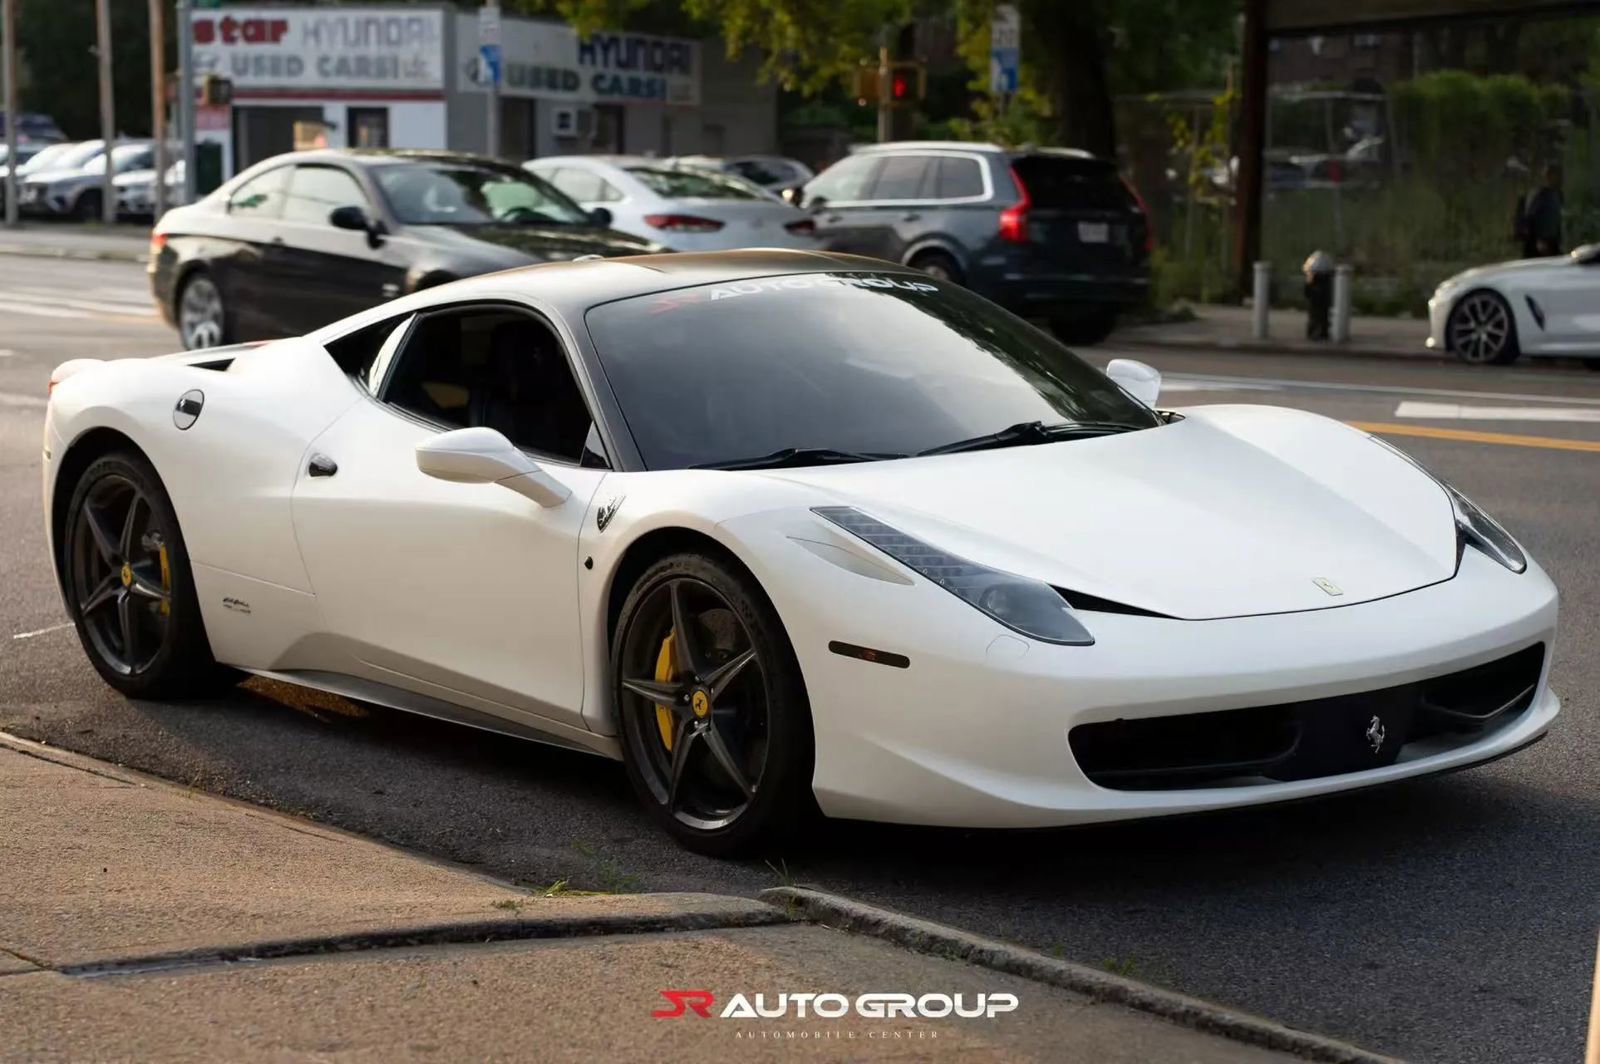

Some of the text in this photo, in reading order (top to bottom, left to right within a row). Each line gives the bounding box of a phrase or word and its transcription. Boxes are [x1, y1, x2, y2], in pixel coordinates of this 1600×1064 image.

[231, 53, 305, 78] USED
[506, 63, 581, 92] USED
[710, 276, 812, 301] AUTO
